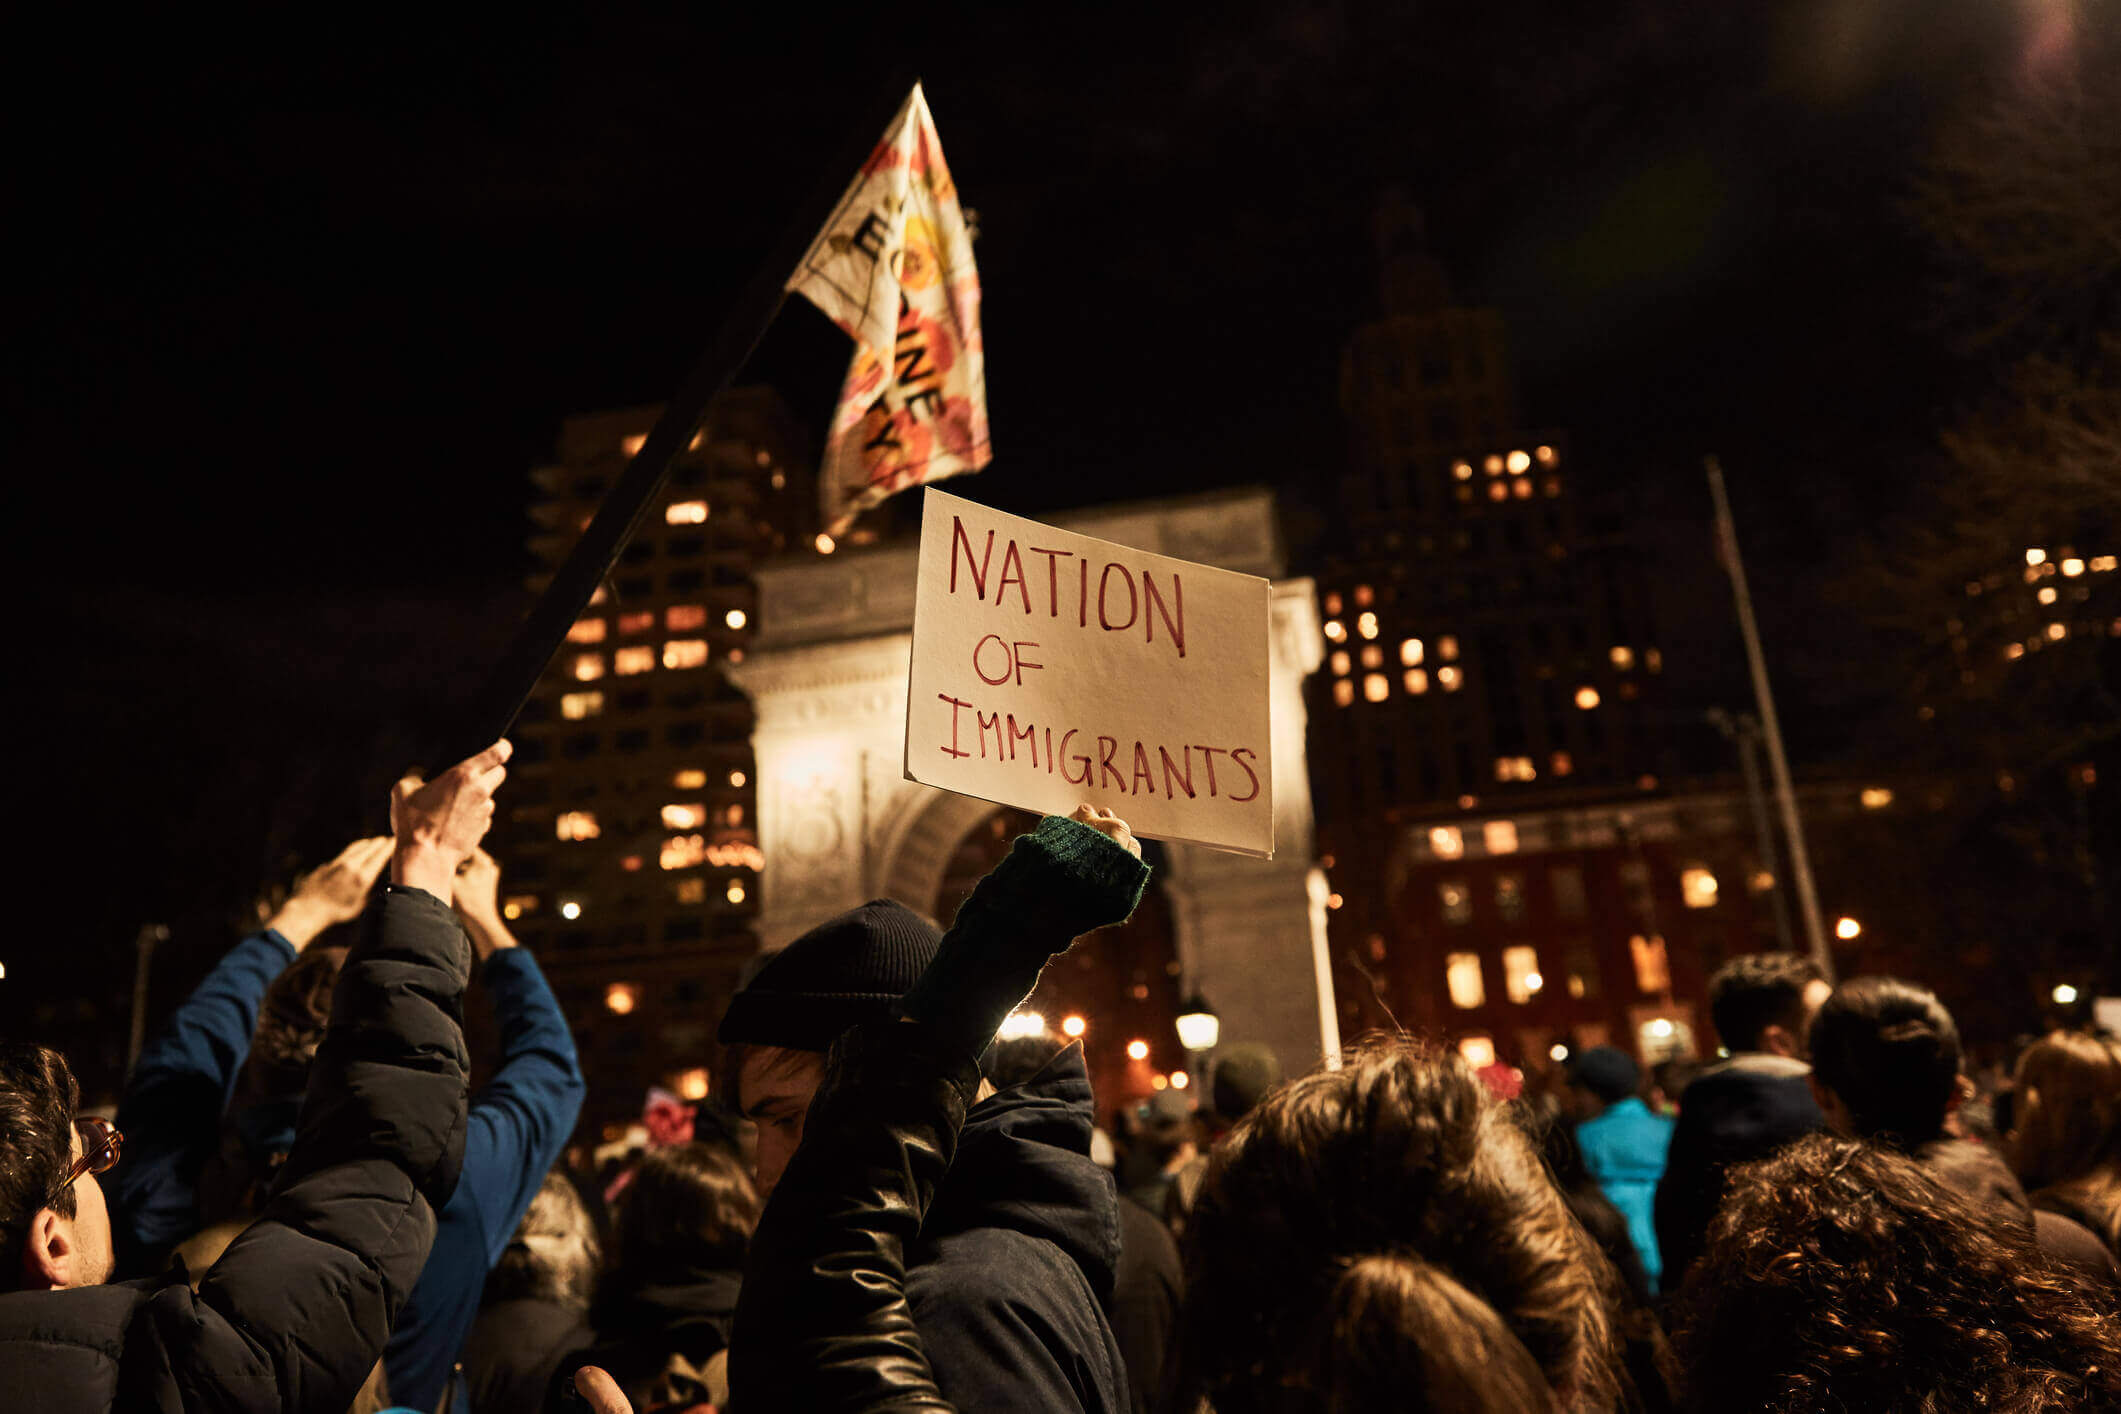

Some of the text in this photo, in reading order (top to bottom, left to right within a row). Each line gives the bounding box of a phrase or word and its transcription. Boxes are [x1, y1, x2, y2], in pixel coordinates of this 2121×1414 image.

[950, 516, 1186, 658] NATION
[973, 634, 1044, 686] OF
[938, 693, 1260, 801] IMMIGRANTS
